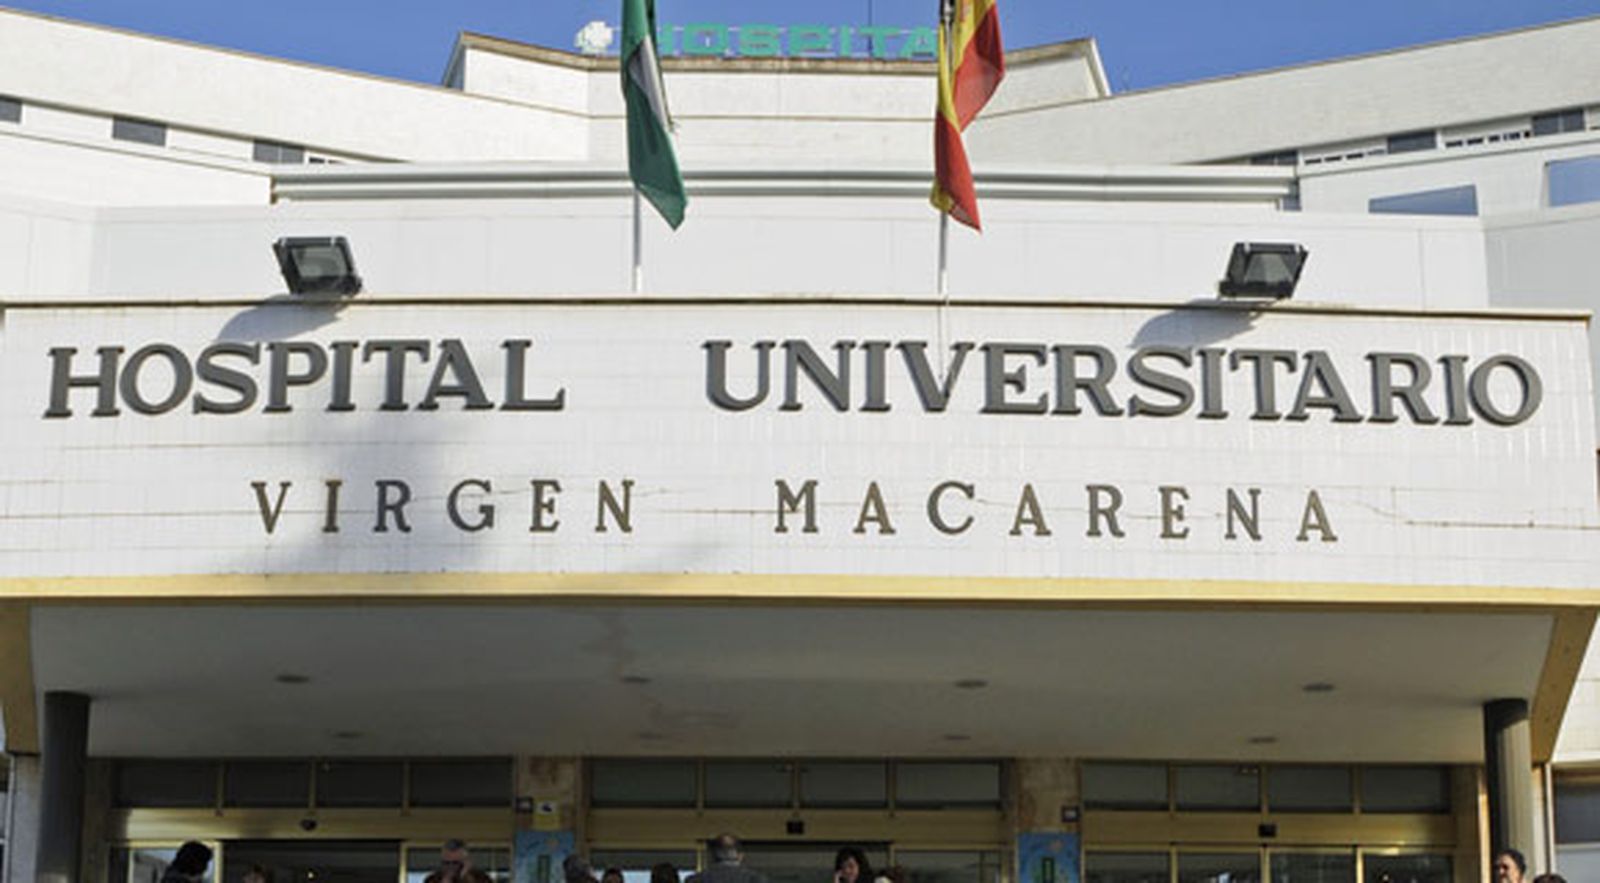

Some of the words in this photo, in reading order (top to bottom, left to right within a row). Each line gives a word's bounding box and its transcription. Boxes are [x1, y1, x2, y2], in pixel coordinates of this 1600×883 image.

[657, 21, 939, 58] OSPITA
[42, 338, 566, 419] HOSPITAL
[700, 339, 1543, 427] UNIVERSITARIO
[250, 478, 636, 534] VIRGEN
[774, 479, 1338, 542] MACARENA
